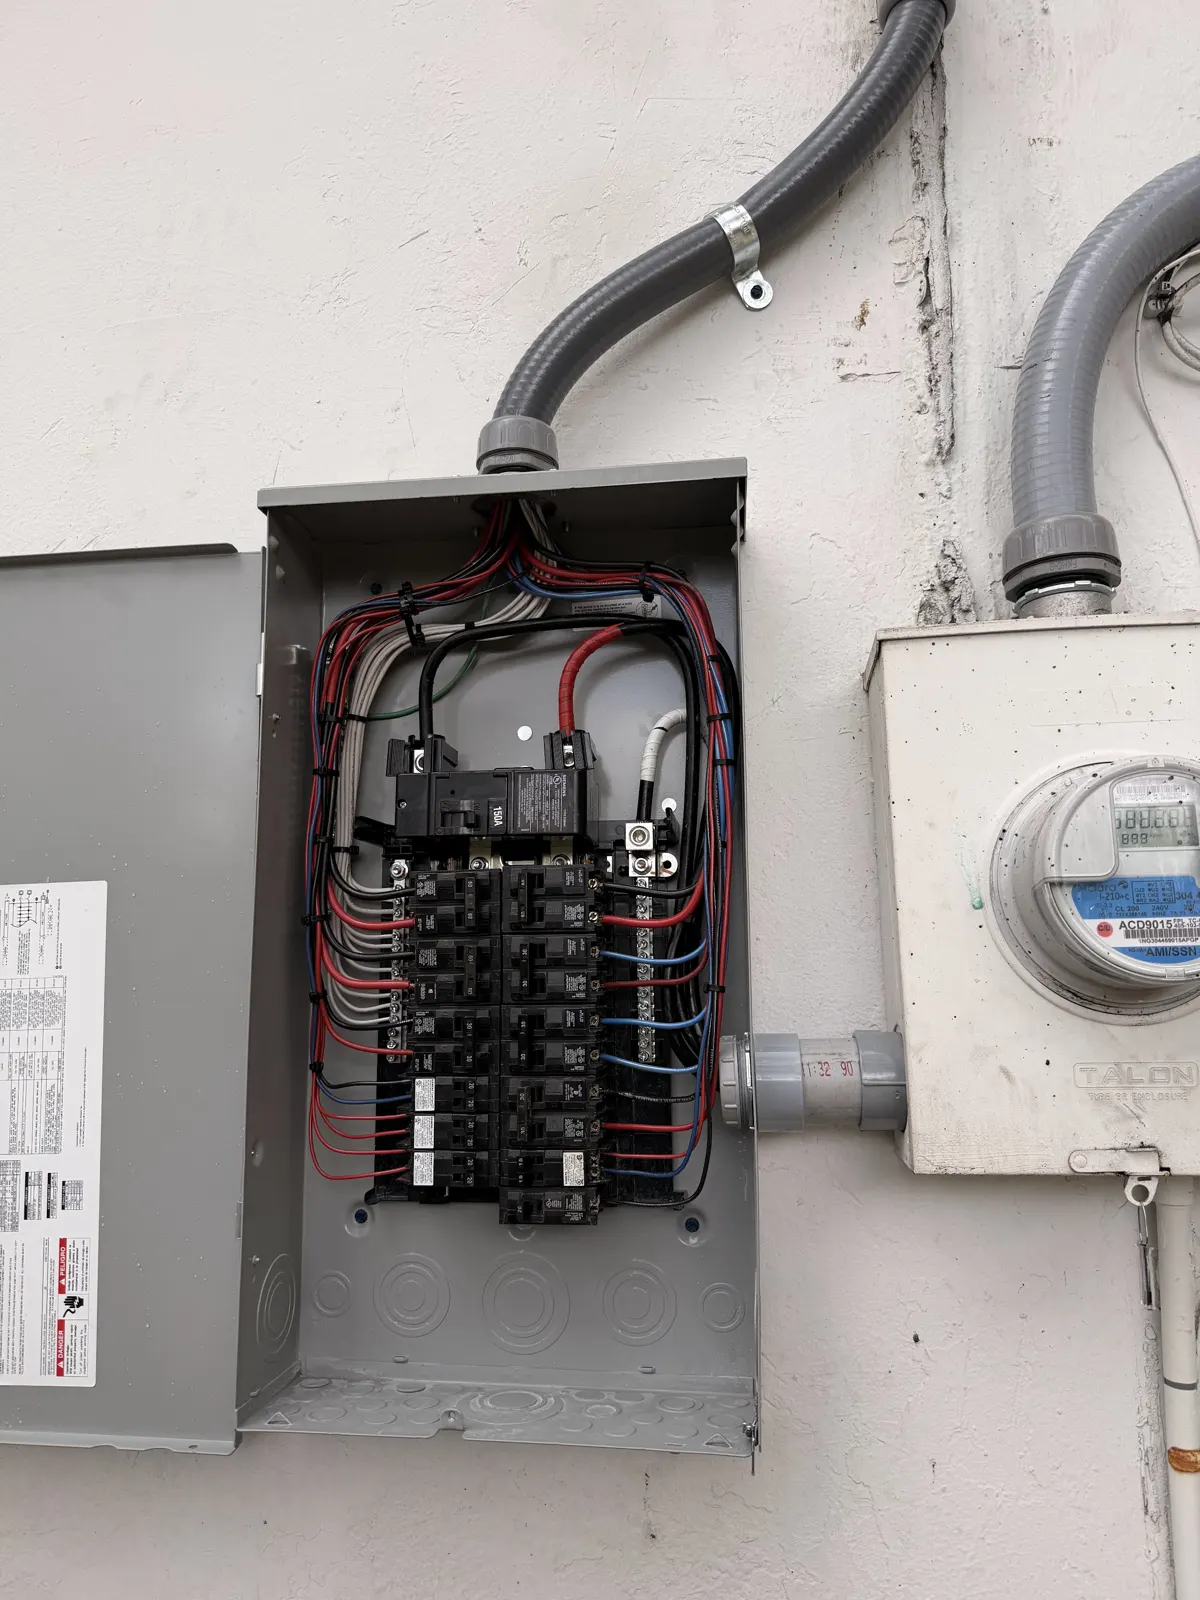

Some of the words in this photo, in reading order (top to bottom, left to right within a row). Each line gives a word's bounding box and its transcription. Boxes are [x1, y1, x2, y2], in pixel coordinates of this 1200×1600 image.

[493, 806, 503, 826] 150A
[1176, 892, 1193, 900] 304
[1119, 920, 1172, 930] ACD9015
[1146, 946, 1196, 956] AMI/SSN
[1078, 1066, 1193, 1085] TALON
[1132, 1092, 1188, 1101] ENCLOSURE
